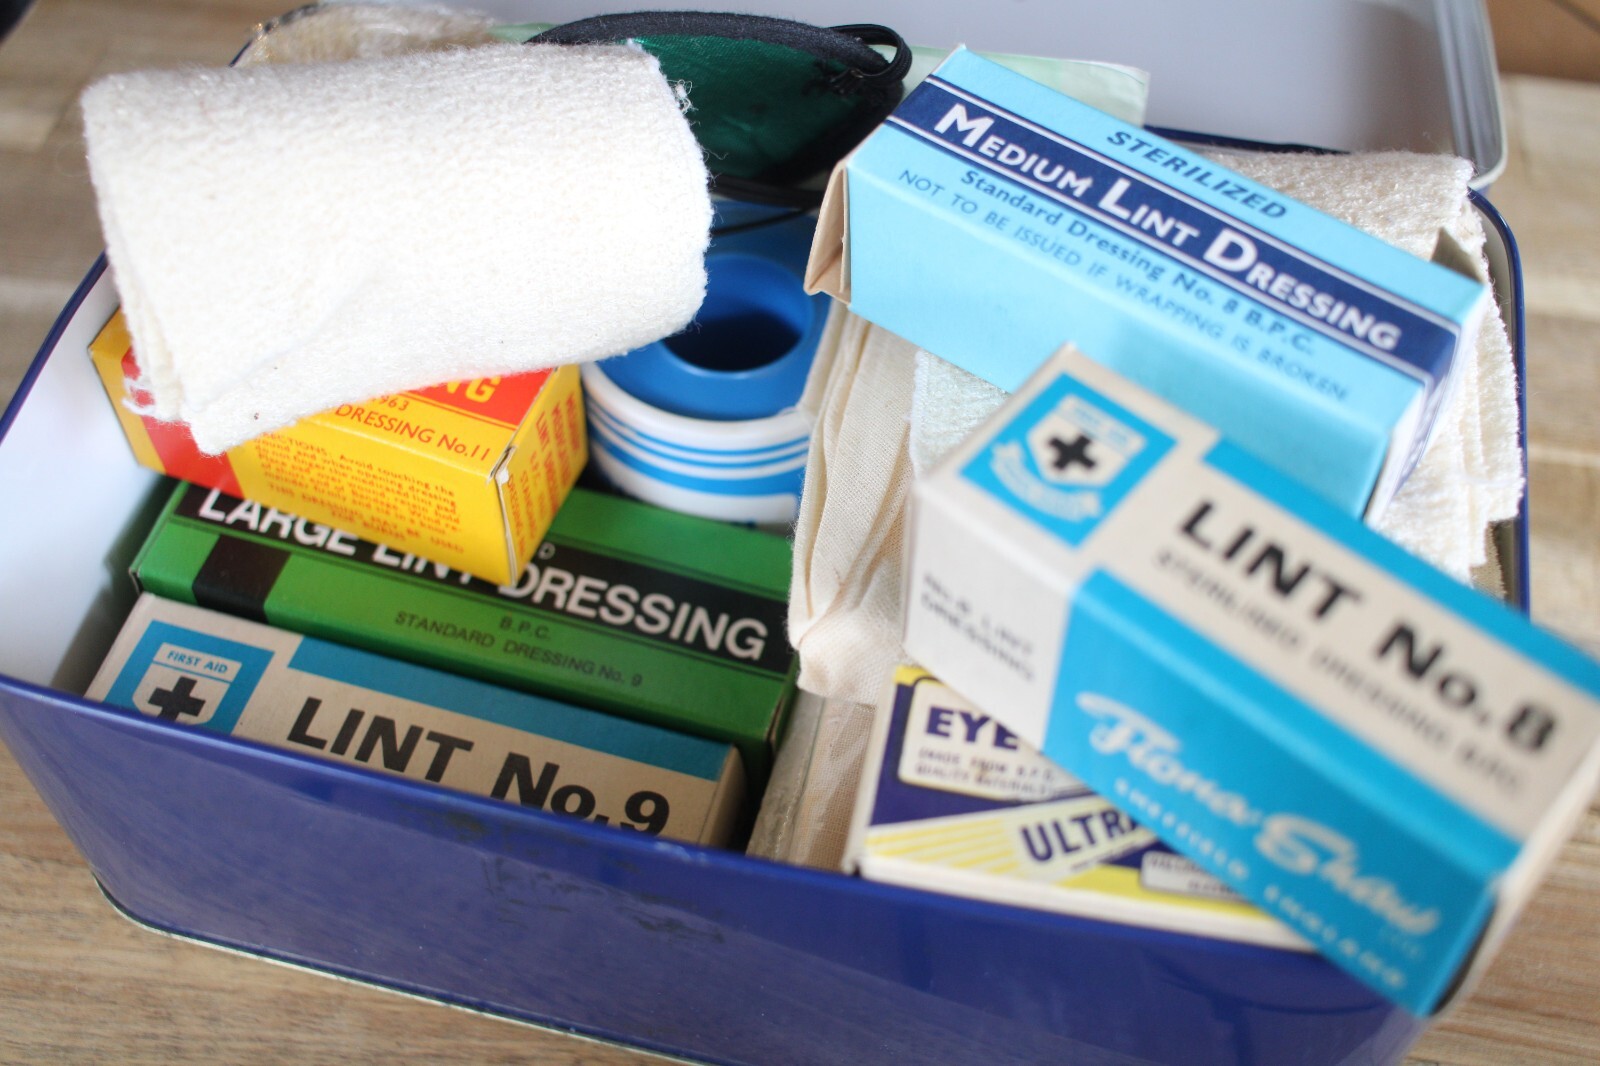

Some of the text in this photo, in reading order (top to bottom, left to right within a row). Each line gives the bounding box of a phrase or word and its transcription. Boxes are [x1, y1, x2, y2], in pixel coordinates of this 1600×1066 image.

[1106, 130, 1287, 218] STERILIZED
[933, 103, 1402, 350] MEDIUM LINT DRESSING
[960, 170, 1063, 226] Standard
[1067, 219, 1165, 282] Dressing
[1172, 272, 1213, 304] No.
[1222, 298, 1239, 314] 8
[898, 169, 1347, 402] NOT TO BE ISSUED IF WRAPPING IS BROKEN
[335, 404, 435, 444] DRESSING
[1179, 501, 1364, 620] LINT
[395, 611, 495, 648] STANDARD
[502, 638, 595, 674] DRESSING
[498, 562, 768, 661] DRESSING
[166, 650, 228, 674] FIRST AID
[287, 696, 474, 783] LINT
[925, 706, 1018, 750] EYE
